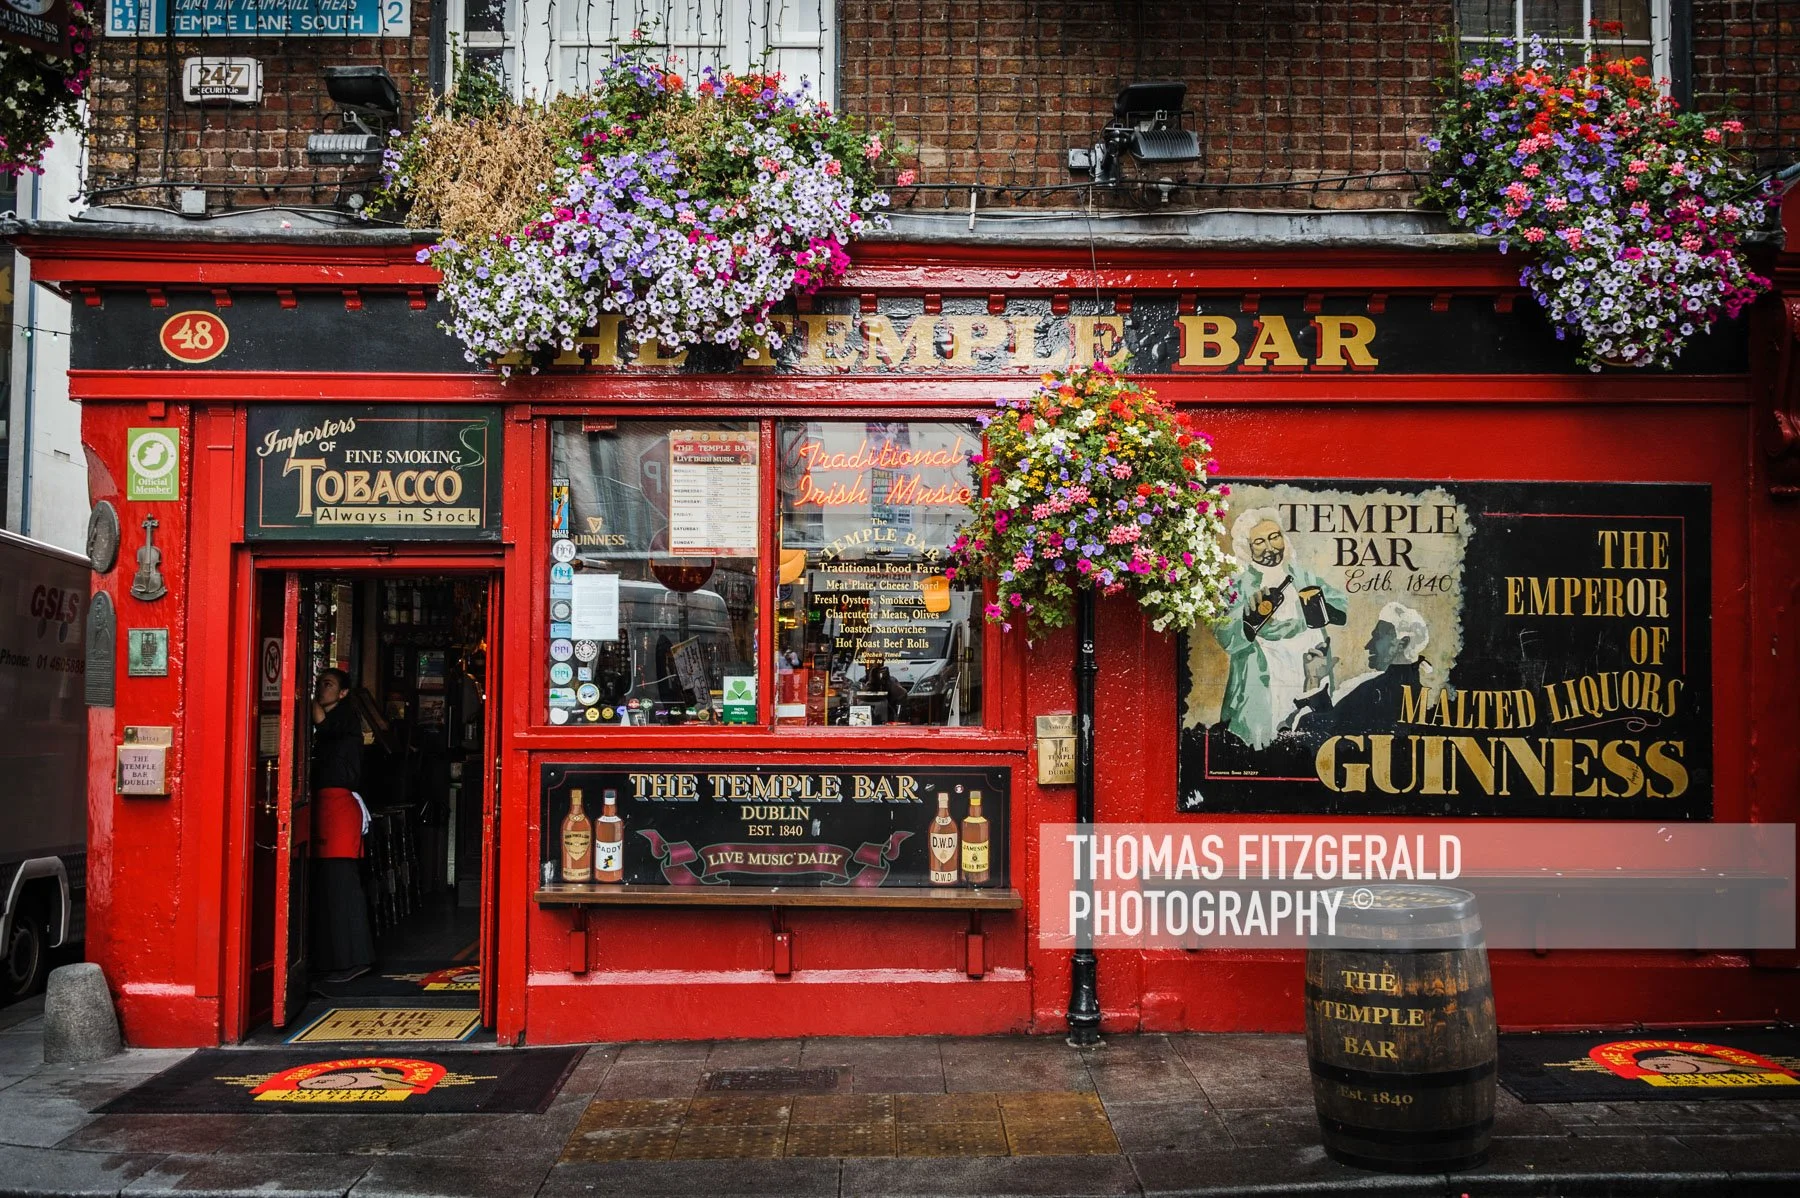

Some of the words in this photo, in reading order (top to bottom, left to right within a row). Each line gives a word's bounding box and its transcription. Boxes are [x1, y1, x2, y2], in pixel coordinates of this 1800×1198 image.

[245, 15, 292, 30] LANE
[301, 15, 364, 30] SOUTH
[388, 1, 403, 24] 2
[171, 319, 213, 350] 48
[1172, 315, 1379, 370] BAR
[257, 416, 356, 458] Importers
[319, 441, 337, 452] OF
[345, 450, 383, 464] FINE
[386, 449, 463, 464] SMOKING
[799, 436, 964, 471] Traditional
[138, 478, 167, 486] Official
[282, 457, 463, 518] TOBACCO
[793, 474, 868, 506] Irish
[884, 474, 972, 505] Music
[319, 508, 387, 523] Always
[398, 510, 414, 522] in
[422, 508, 477, 522] Stock
[870, 518, 887, 526] The
[1278, 503, 1460, 534] TEMPLE
[820, 528, 897, 561] TEMPLE
[904, 532, 940, 562] BAR
[1332, 537, 1419, 571] BAR
[1597, 530, 1669, 570] THE
[819, 562, 881, 573] Traditional
[884, 563, 912, 573] Food
[916, 563, 940, 573] Fare
[826, 580, 848, 590] Meat
[851, 580, 876, 591] Plate,
[879, 580, 909, 591] Cheese
[913, 580, 939, 591] Board
[1406, 574, 1453, 595] 1840
[31, 584, 79, 624] GSLS
[814, 594, 838, 604] Fresh
[841, 594, 877, 607] Oysters,
[880, 594, 915, 605] Smoked
[1505, 576, 1670, 618] EMPEROR
[825, 609, 878, 620] Charcuterie
[881, 609, 910, 620] Meats,
[912, 609, 940, 620] Olives
[838, 624, 873, 634] Toasted
[875, 624, 926, 634] Sandwiches
[835, 638, 852, 648] Hot
[855, 638, 880, 649] Roast
[884, 638, 904, 649] Beef
[907, 638, 929, 649] Rolls
[1629, 626, 1669, 665] OF
[1397, 684, 1537, 731] MALTED
[1543, 670, 1684, 724] LIQUORS
[1315, 734, 1690, 799] GUINNESS
[629, 773, 700, 802] THE
[707, 773, 843, 803] TEMPLE
[852, 774, 923, 803] BAR
[740, 805, 811, 821] DUBLIN
[748, 825, 775, 836] EST.
[778, 825, 804, 837] 1840
[932, 836, 956, 849] D.W.D.
[709, 852, 744, 866] LIVE
[748, 852, 795, 866] MUSIC
[798, 852, 842, 866] DAILY
[1341, 970, 1396, 992] THE
[328, 1020, 469, 1028] TEMPLE
[377, 1012, 441, 1020] THE
[1321, 1000, 1425, 1027] TEMPLE
[351, 1028, 423, 1036] BAR
[1343, 1036, 1399, 1059] BAR
[1339, 1086, 1367, 1101] Est.
[1372, 1091, 1414, 1106] 1840
